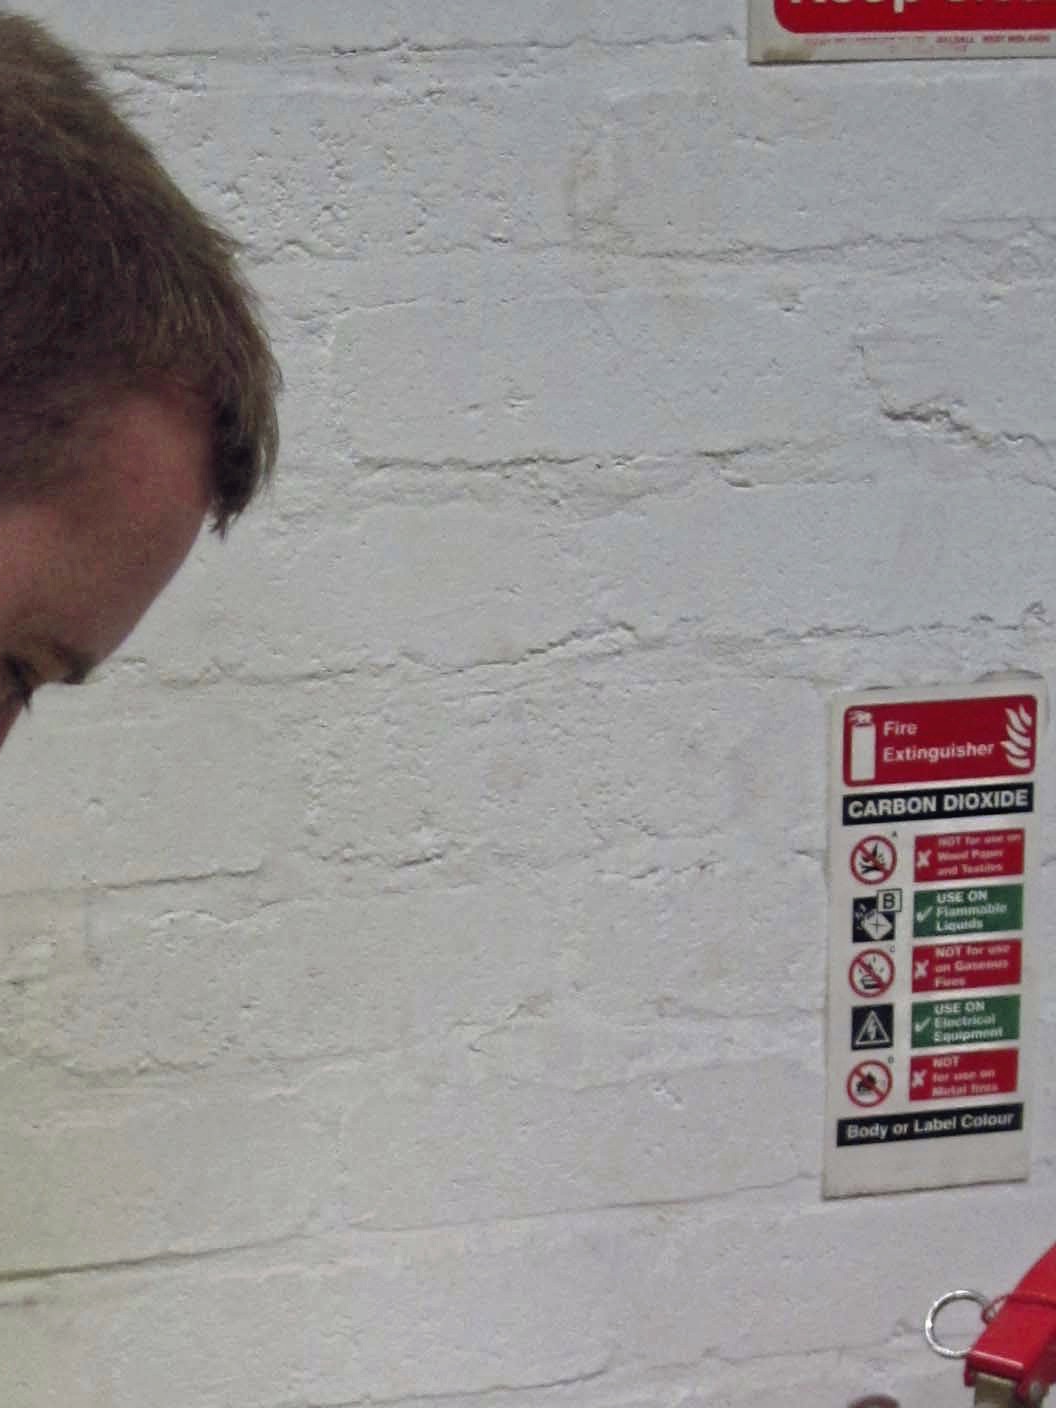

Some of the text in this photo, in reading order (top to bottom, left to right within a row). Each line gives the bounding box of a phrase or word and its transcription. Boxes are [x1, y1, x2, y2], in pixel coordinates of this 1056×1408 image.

[883, 720, 918, 736] Fire
[883, 742, 995, 764] Extinguisher
[848, 789, 1029, 818] CARBON DIOXIDE
[938, 833, 1021, 847] NOT for use on
[937, 848, 1003, 862] Wood Paper
[937, 866, 958, 876] and
[883, 893, 896, 909] B
[937, 889, 988, 904] USE ON
[936, 903, 1008, 918] Flammable
[936, 919, 984, 932] Liquids
[935, 944, 1010, 957] NOT for use
[935, 959, 1008, 973] on Gaseous
[934, 1000, 985, 1015] USE ON
[934, 1013, 996, 1029] Electrical
[934, 1026, 1003, 1043] Equipment
[933, 1055, 960, 1068] NOT
[932, 1069, 996, 1082] for use on
[932, 1085, 967, 1097] Metal
[847, 1112, 1015, 1139] Body or Label Colour
